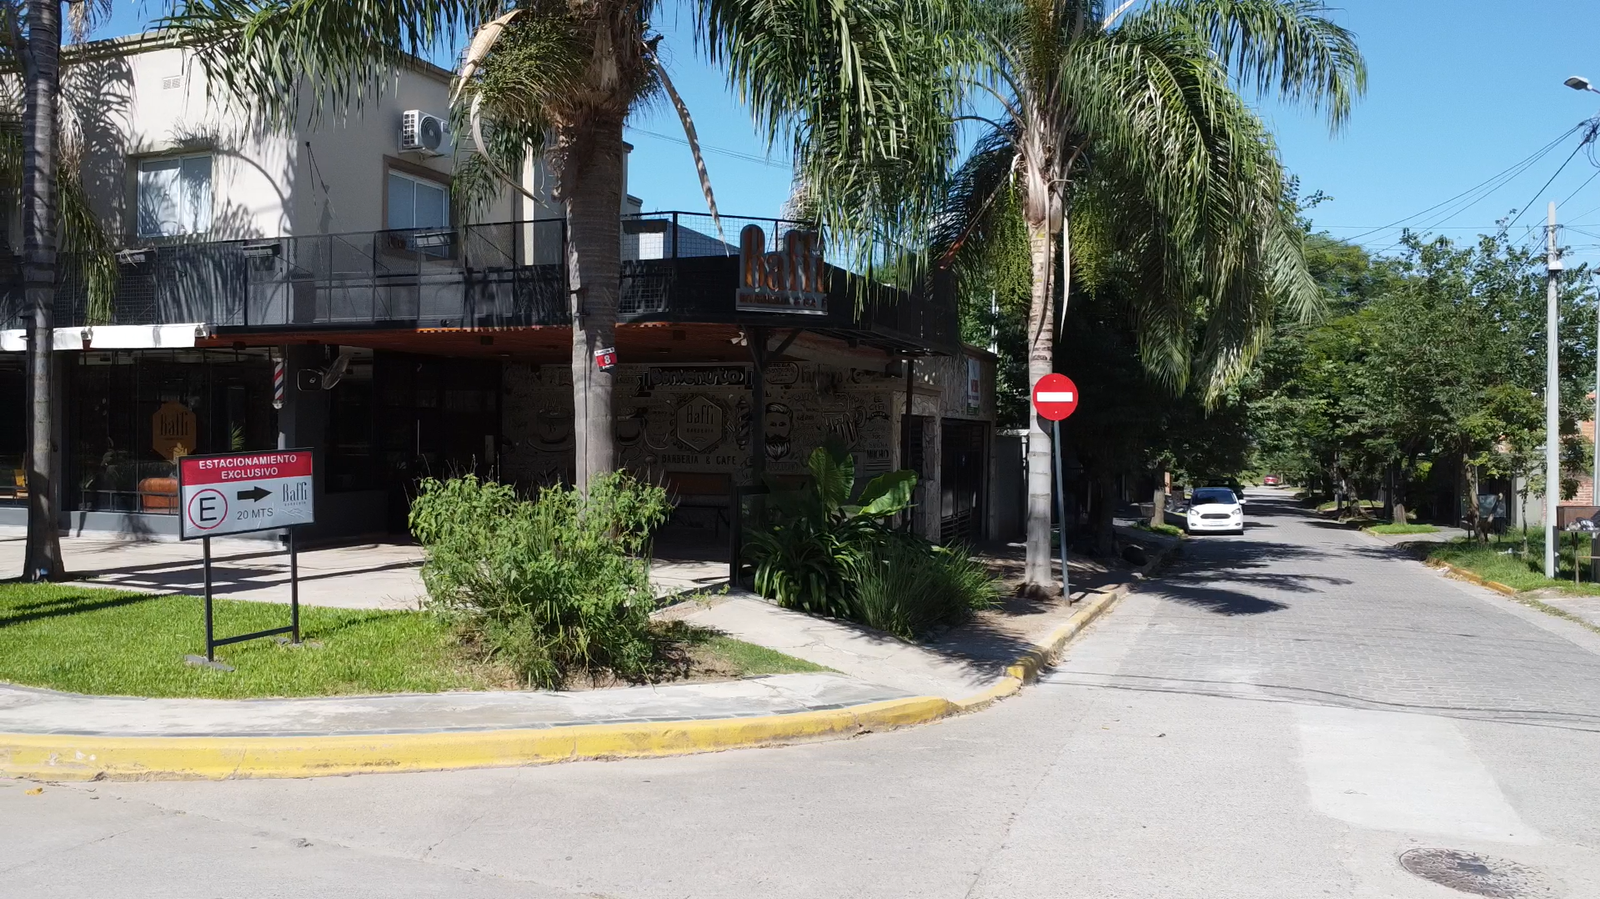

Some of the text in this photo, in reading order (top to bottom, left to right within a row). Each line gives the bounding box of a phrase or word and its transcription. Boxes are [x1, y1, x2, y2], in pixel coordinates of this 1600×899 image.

[604, 354, 611, 365] 8
[686, 404, 714, 425] Baffi
[199, 454, 297, 469] ESTACIONAMIENTO
[661, 454, 736, 465] BARBERIA & CAFE
[221, 467, 278, 480] EXCLUSIVO
[282, 481, 307, 502] Baffi
[199, 496, 217, 522] E
[237, 507, 274, 520] 20 MTS
